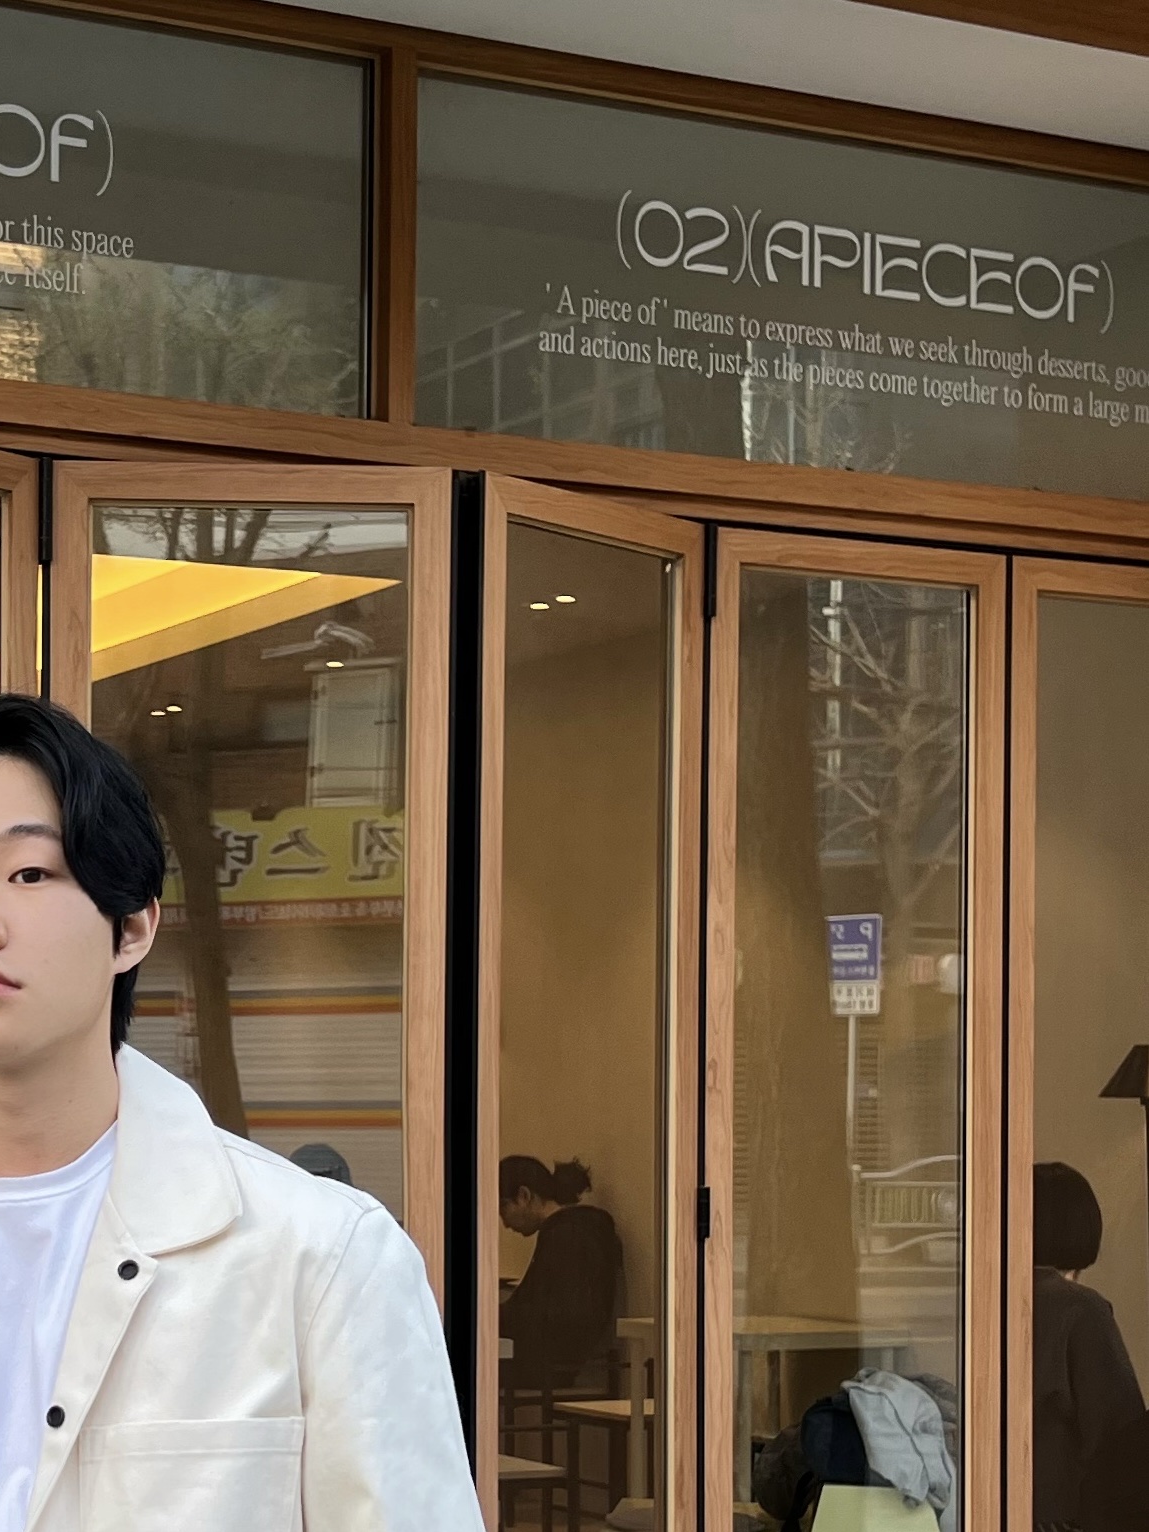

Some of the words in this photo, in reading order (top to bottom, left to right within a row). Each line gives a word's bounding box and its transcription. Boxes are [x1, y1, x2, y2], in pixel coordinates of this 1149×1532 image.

[21, 215, 64, 249] this
[71, 229, 134, 259] space
[538, 326, 575, 355] and
[580, 331, 651, 364] actions
[656, 337, 703, 373] here,
[705, 342, 743, 378] just
[750, 355, 769, 378] as
[773, 352, 803, 382] the
[808, 360, 864, 391] pieces
[869, 371, 918, 396] come
[923, 375, 998, 407] together
[1003, 385, 1023, 408] to
[1028, 383, 1069, 414] form
[1073, 396, 1084, 416] a
[1089, 390, 1129, 427] large
[581, 289, 632, 324] piece
[674, 308, 734, 336] means
[740, 314, 760, 339] to
[765, 320, 833, 349] express
[838, 323, 883, 355] what
[888, 336, 914, 358] we
[919, 335, 958, 364] seek
[963, 339, 1033, 379] through
[1037, 349, 1110, 385] desserts,
